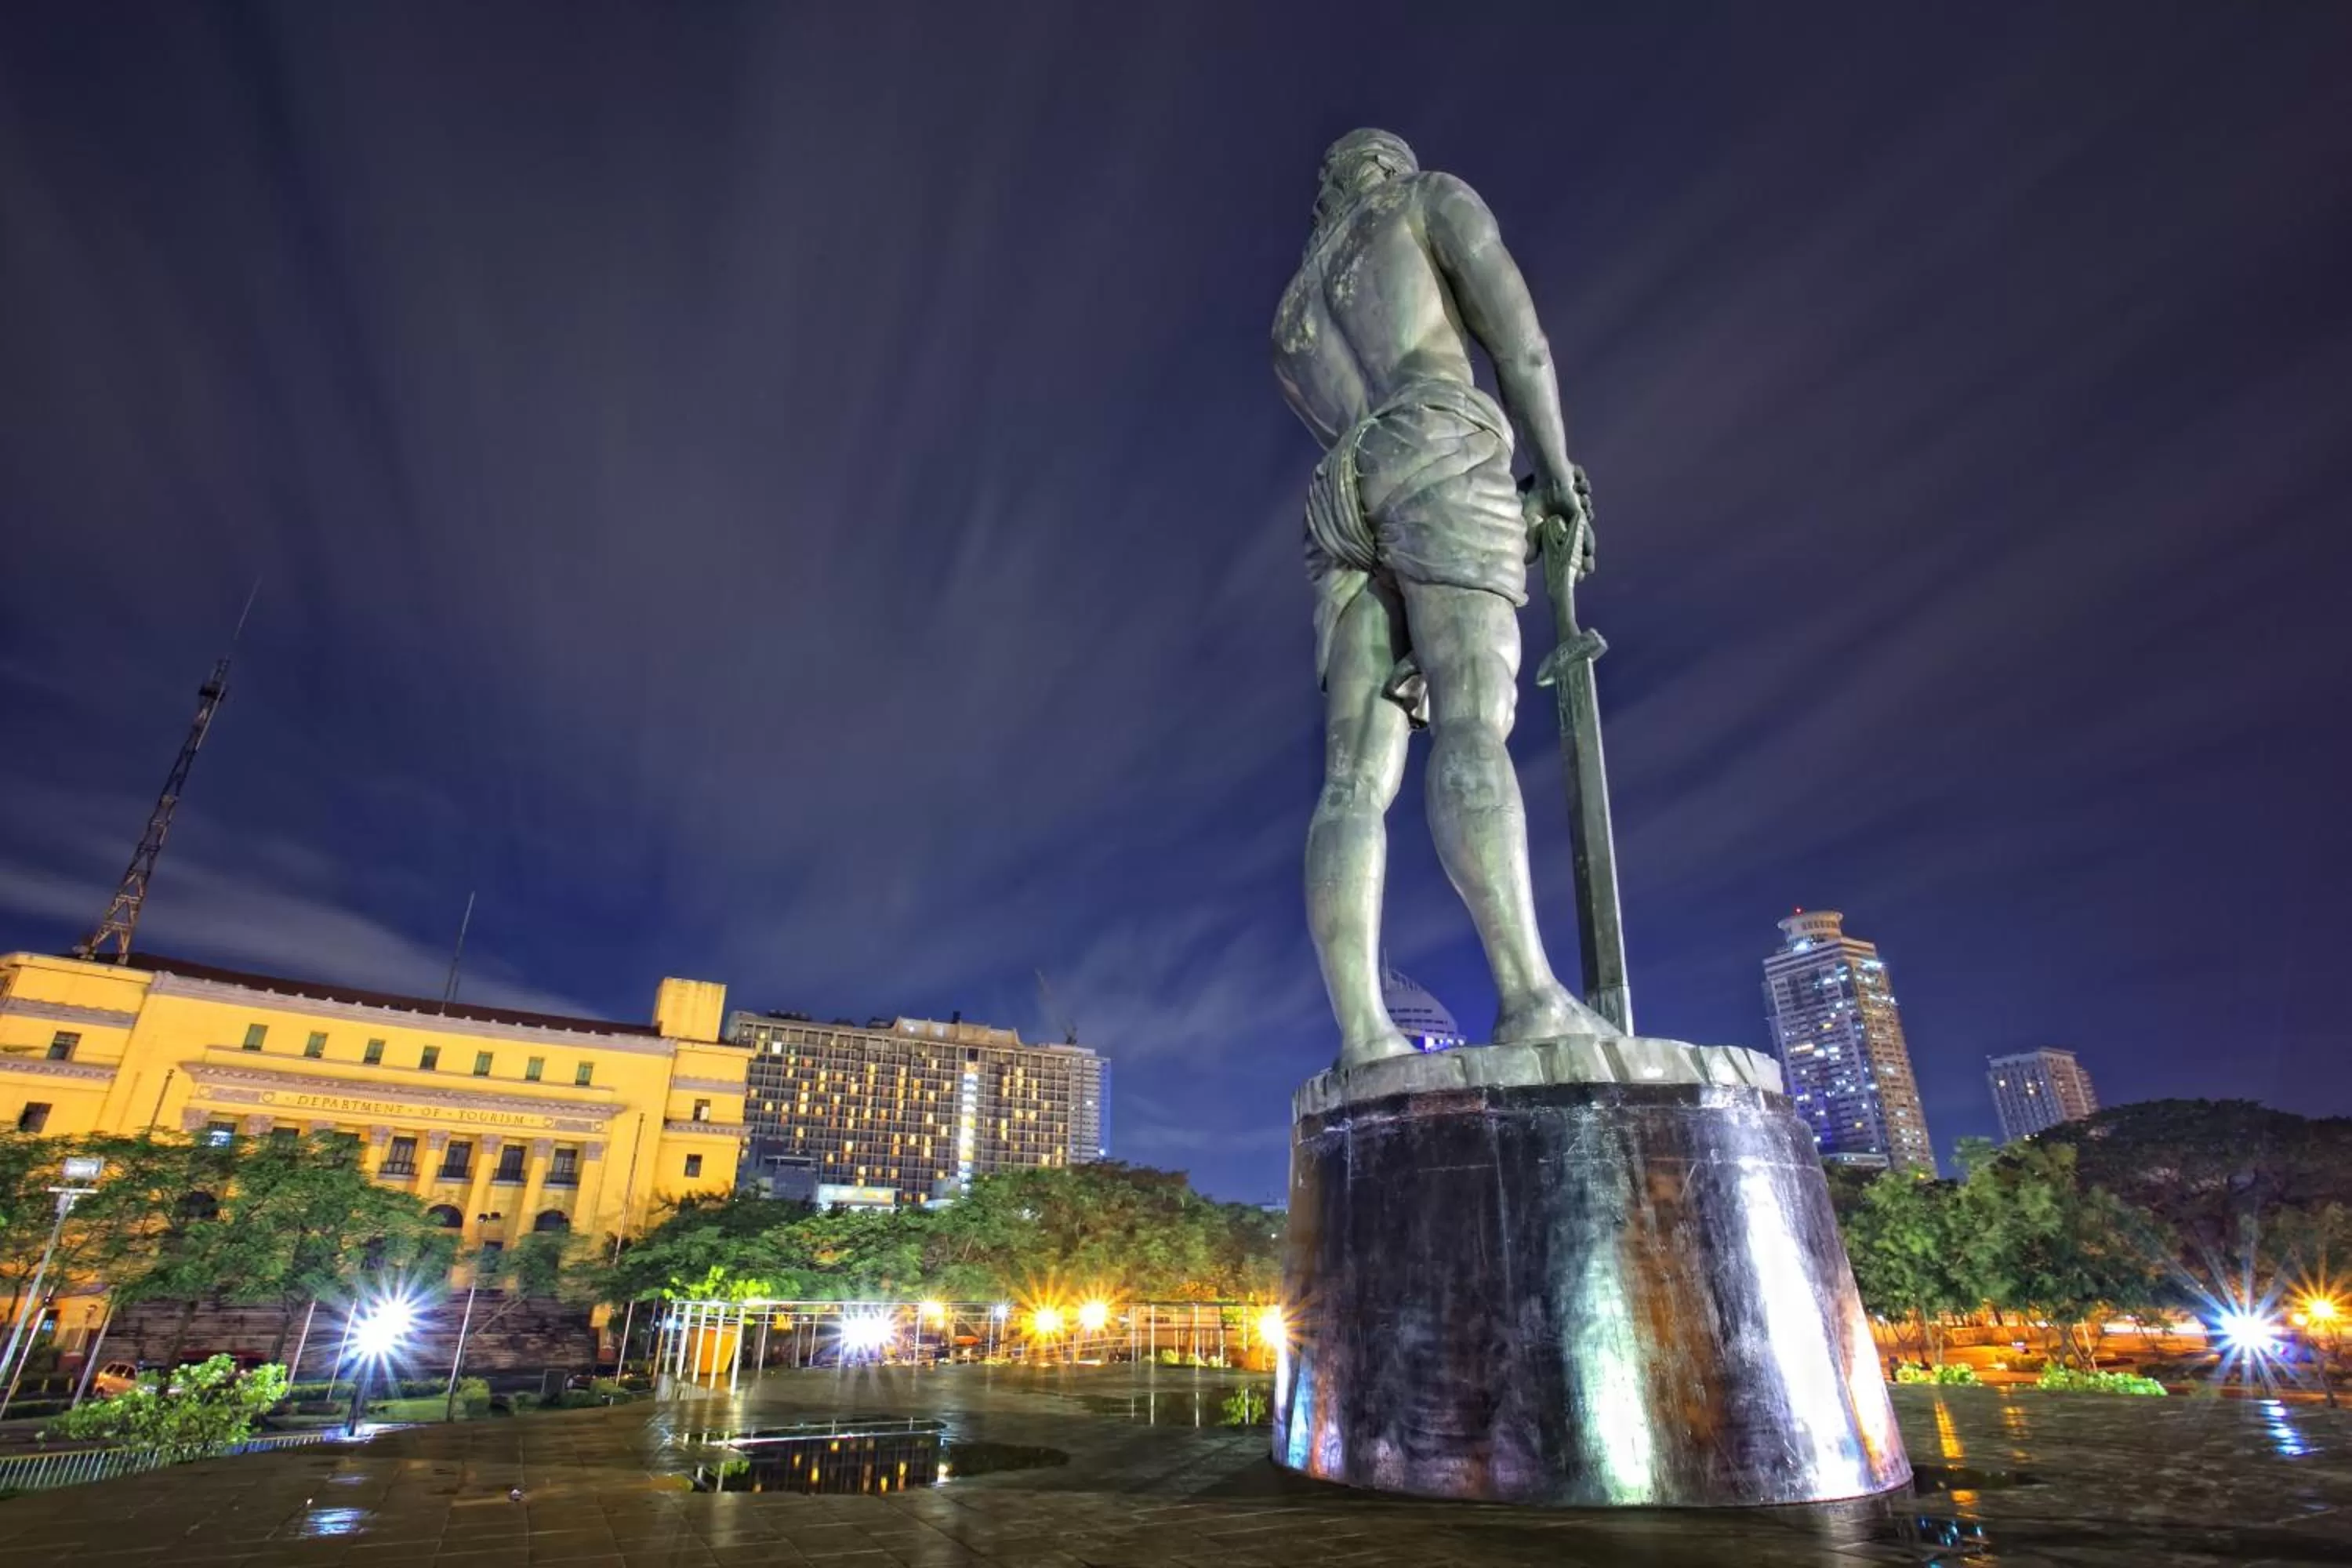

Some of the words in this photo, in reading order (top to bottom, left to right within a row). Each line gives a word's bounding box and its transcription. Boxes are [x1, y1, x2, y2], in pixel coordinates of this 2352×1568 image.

[296, 1095, 404, 1114] DEPARTMENT
[421, 1106, 441, 1117] OF
[459, 1109, 524, 1124] TOURISM
